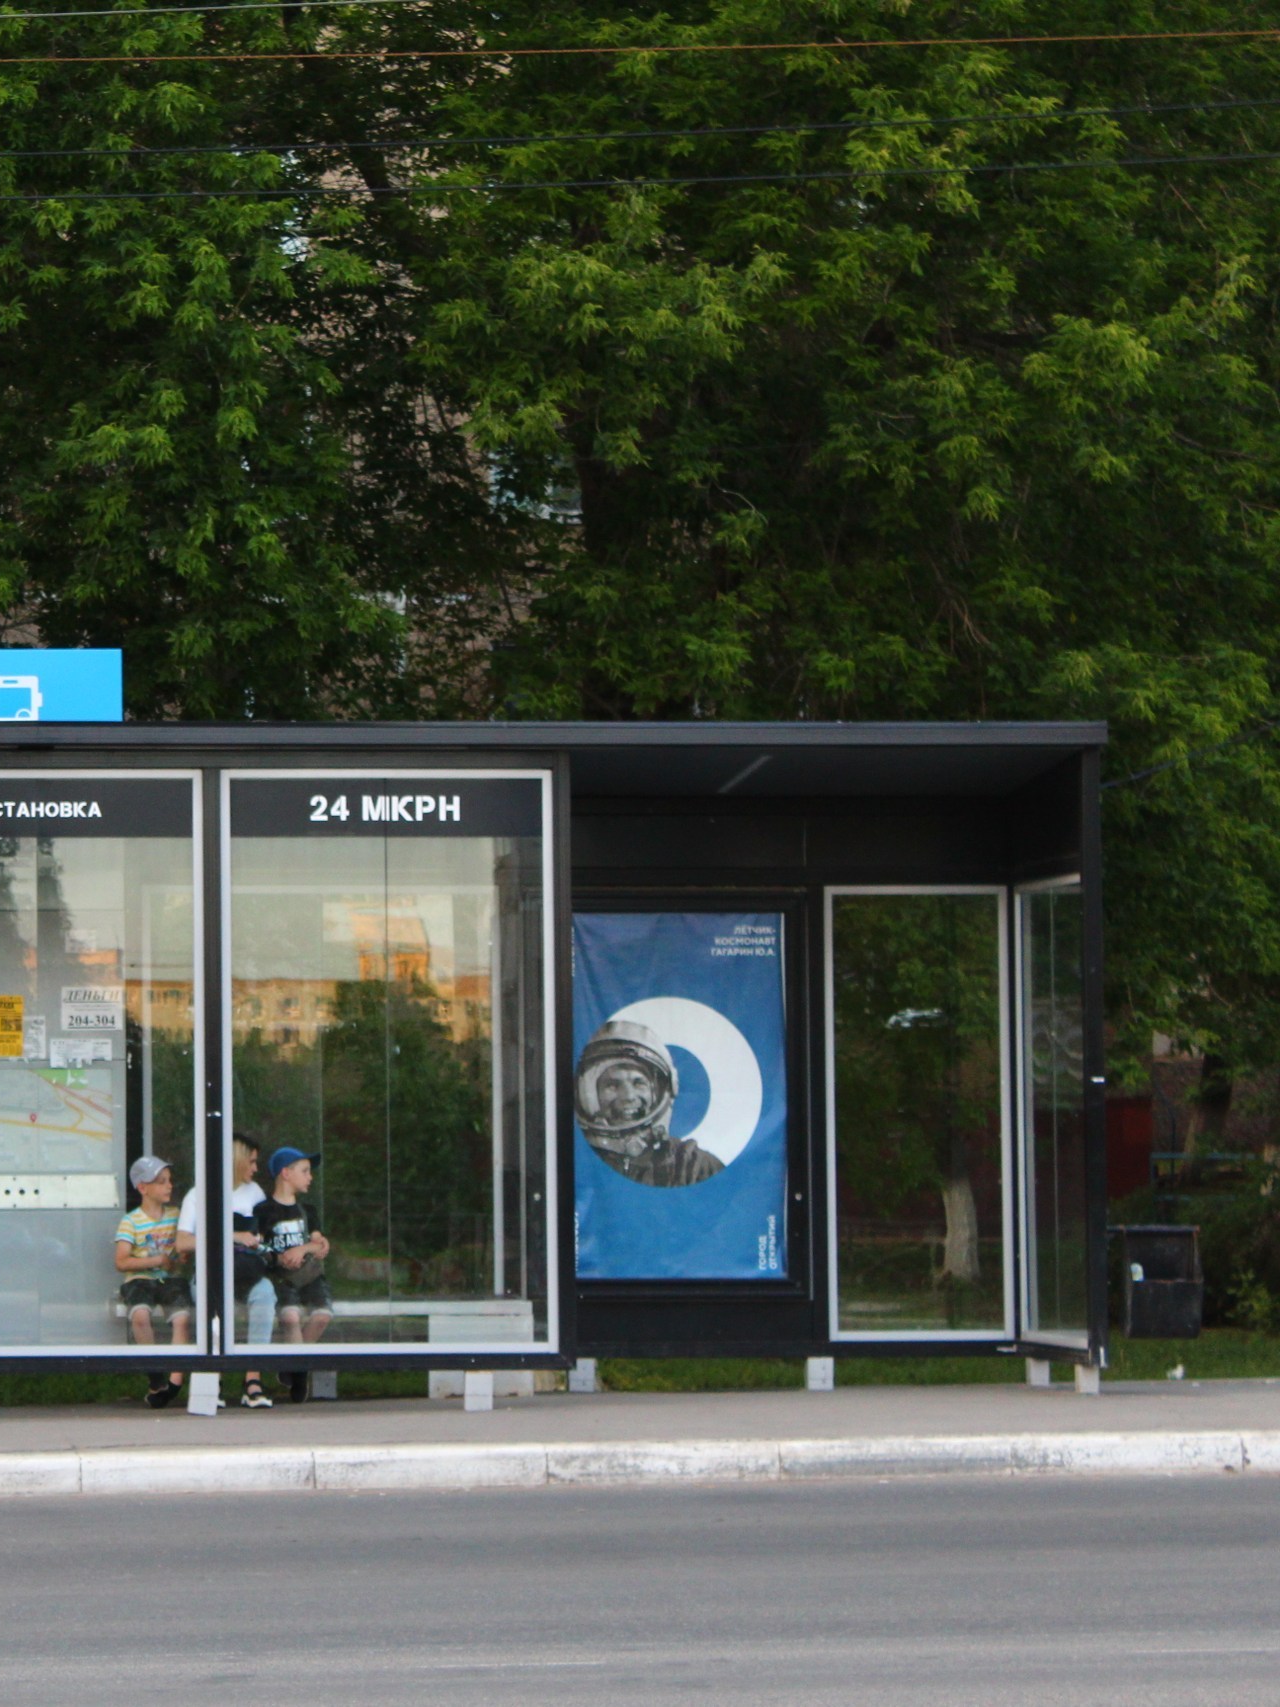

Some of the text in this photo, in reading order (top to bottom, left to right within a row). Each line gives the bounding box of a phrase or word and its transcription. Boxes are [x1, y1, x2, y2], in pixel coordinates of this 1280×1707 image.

[309, 794, 461, 822] 24 МКРН
[714, 936, 776, 946] КОСМОНАВТ
[710, 947, 753, 956] ГАГАРИН
[64, 989, 120, 1003] ДЕНЬГИ
[68, 1014, 116, 1027] 204-304
[758, 1235, 768, 1270] ГОРОД
